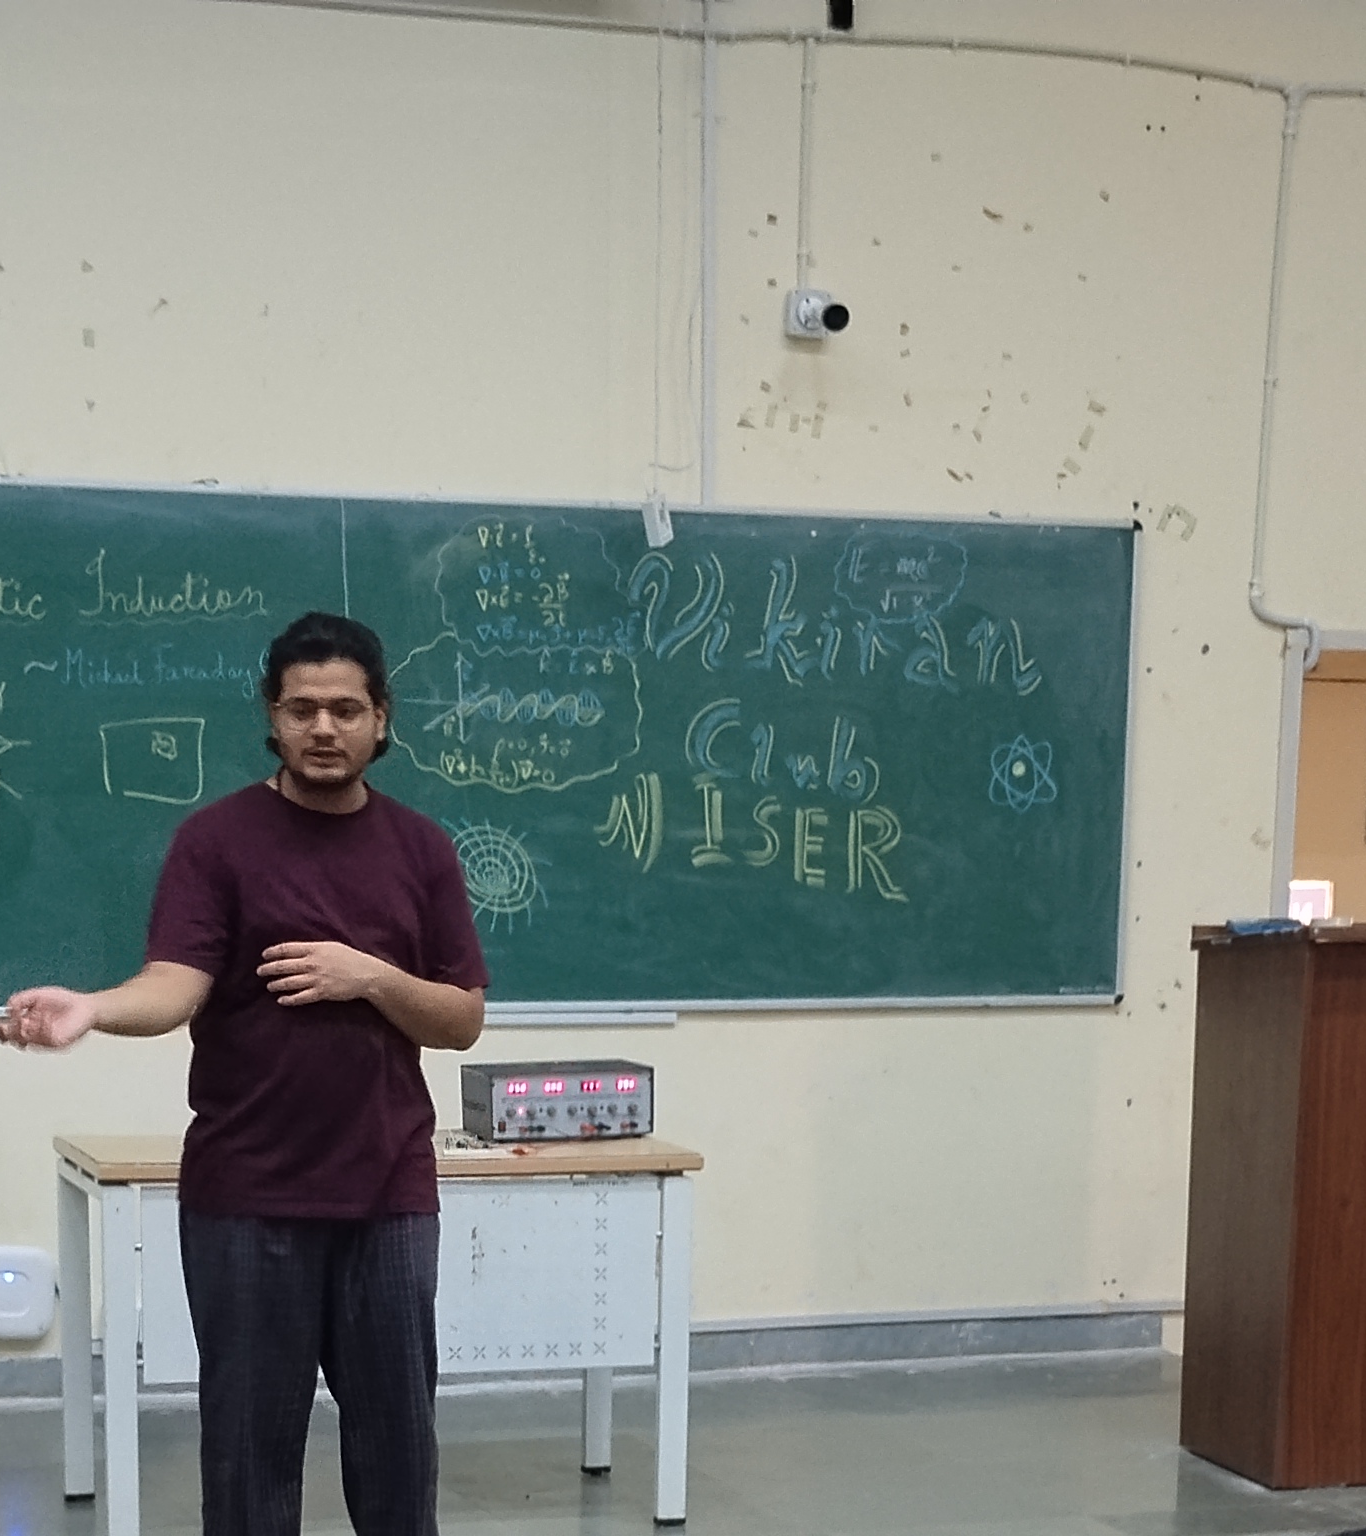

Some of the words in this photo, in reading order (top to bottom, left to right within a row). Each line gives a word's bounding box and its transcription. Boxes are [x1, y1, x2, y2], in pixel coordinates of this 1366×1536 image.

[78, 547, 268, 617] Induction
[154, 643, 255, 699] Faraday
[686, 698, 879, 801] Club
[593, 771, 910, 902] NISER
